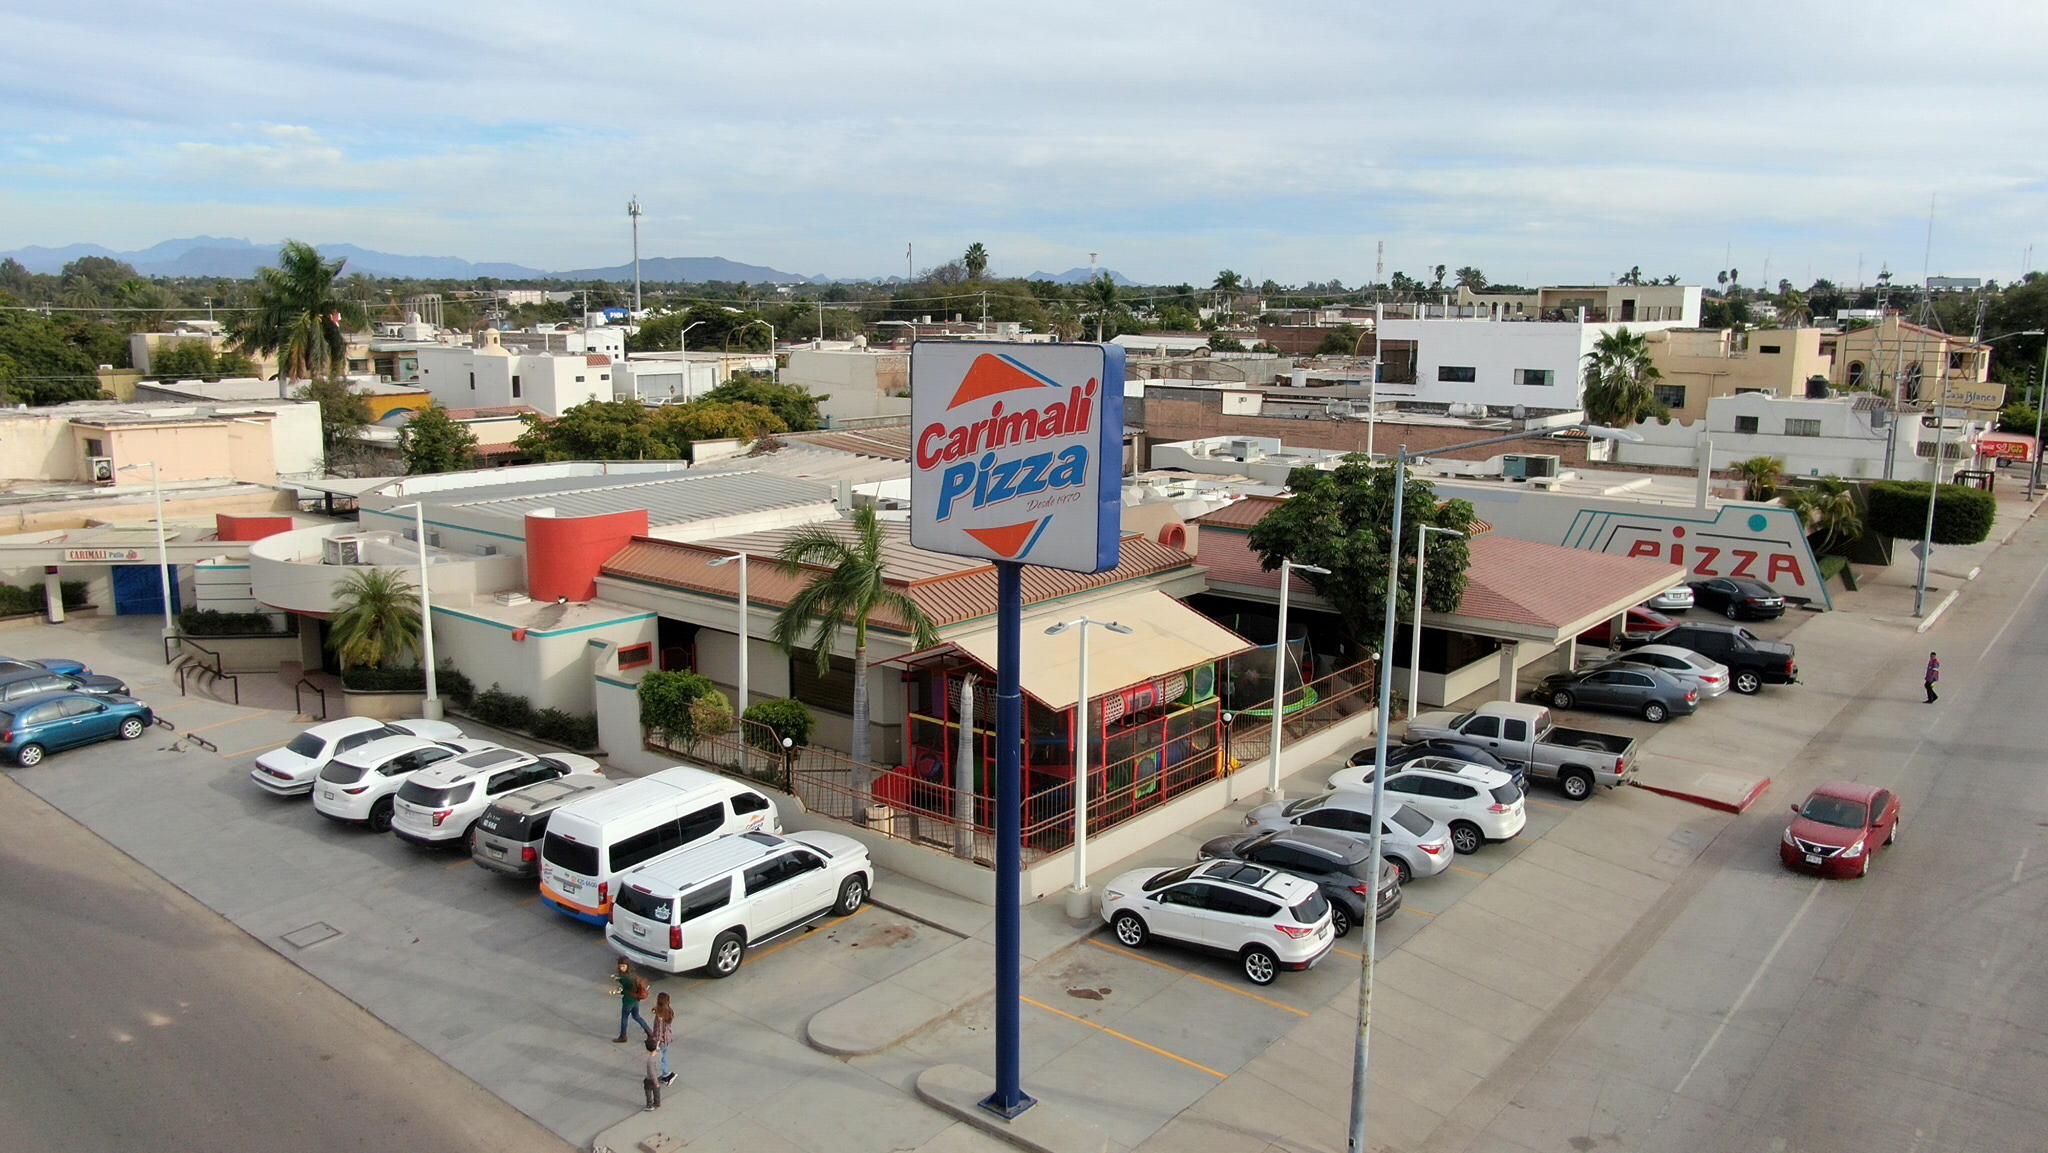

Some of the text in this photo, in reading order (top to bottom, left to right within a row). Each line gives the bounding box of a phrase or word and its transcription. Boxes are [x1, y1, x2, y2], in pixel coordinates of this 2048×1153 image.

[1964, 391, 1996, 404] Blanca
[916, 377, 1098, 471] Carimali
[936, 444, 1090, 523] Pizza
[1026, 492, 1081, 512] Desde 1970
[70, 550, 107, 560] CARIMALI
